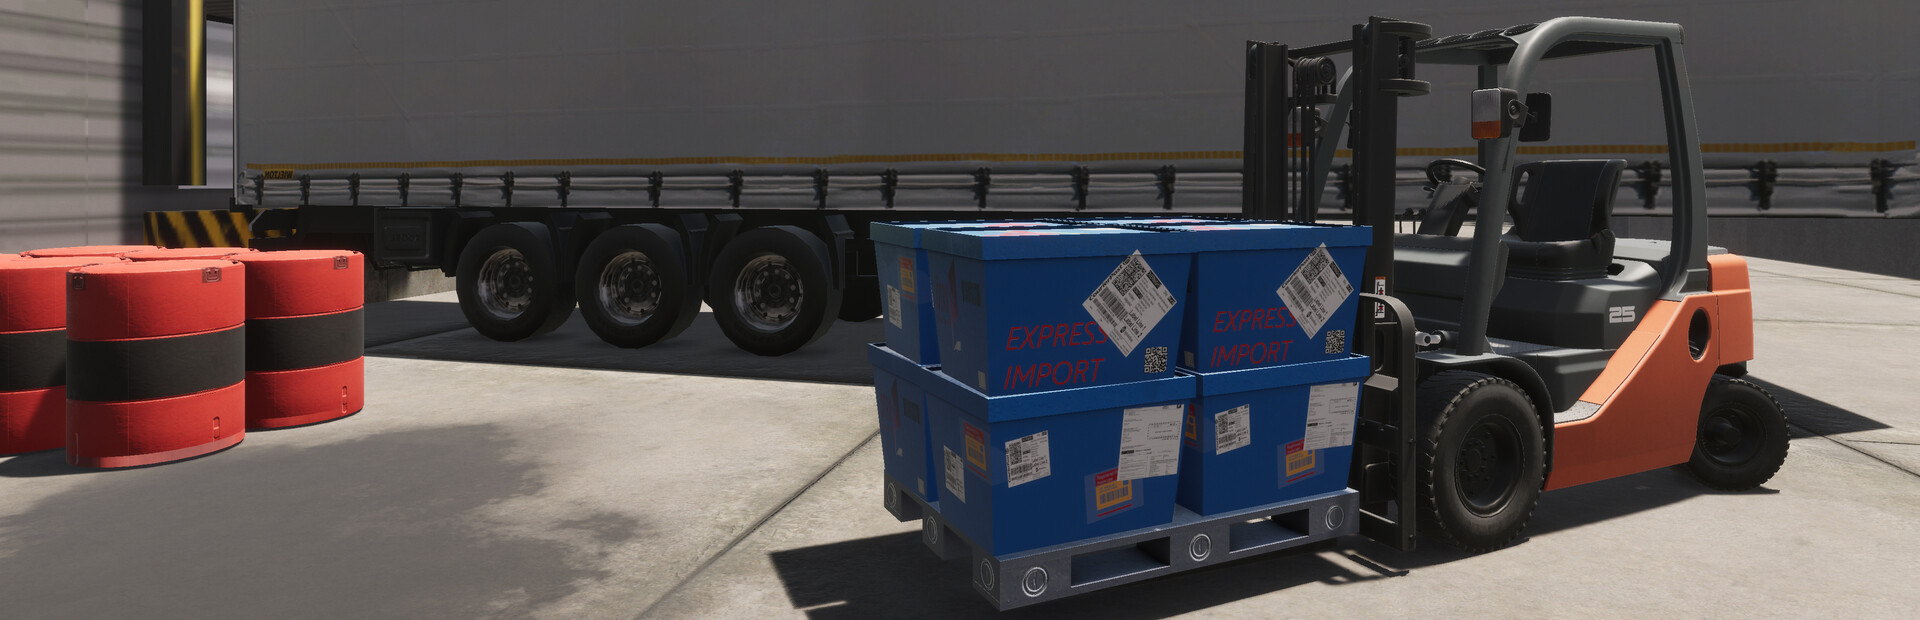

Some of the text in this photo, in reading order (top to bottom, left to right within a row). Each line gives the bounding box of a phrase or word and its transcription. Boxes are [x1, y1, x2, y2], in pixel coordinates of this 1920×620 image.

[1213, 307, 1296, 333] EXPRESS
[1609, 306, 1635, 323] 25
[1006, 321, 1108, 351] EXPRESS
[1210, 340, 1294, 369] IMPORT
[1004, 358, 1105, 390] IMPORT
